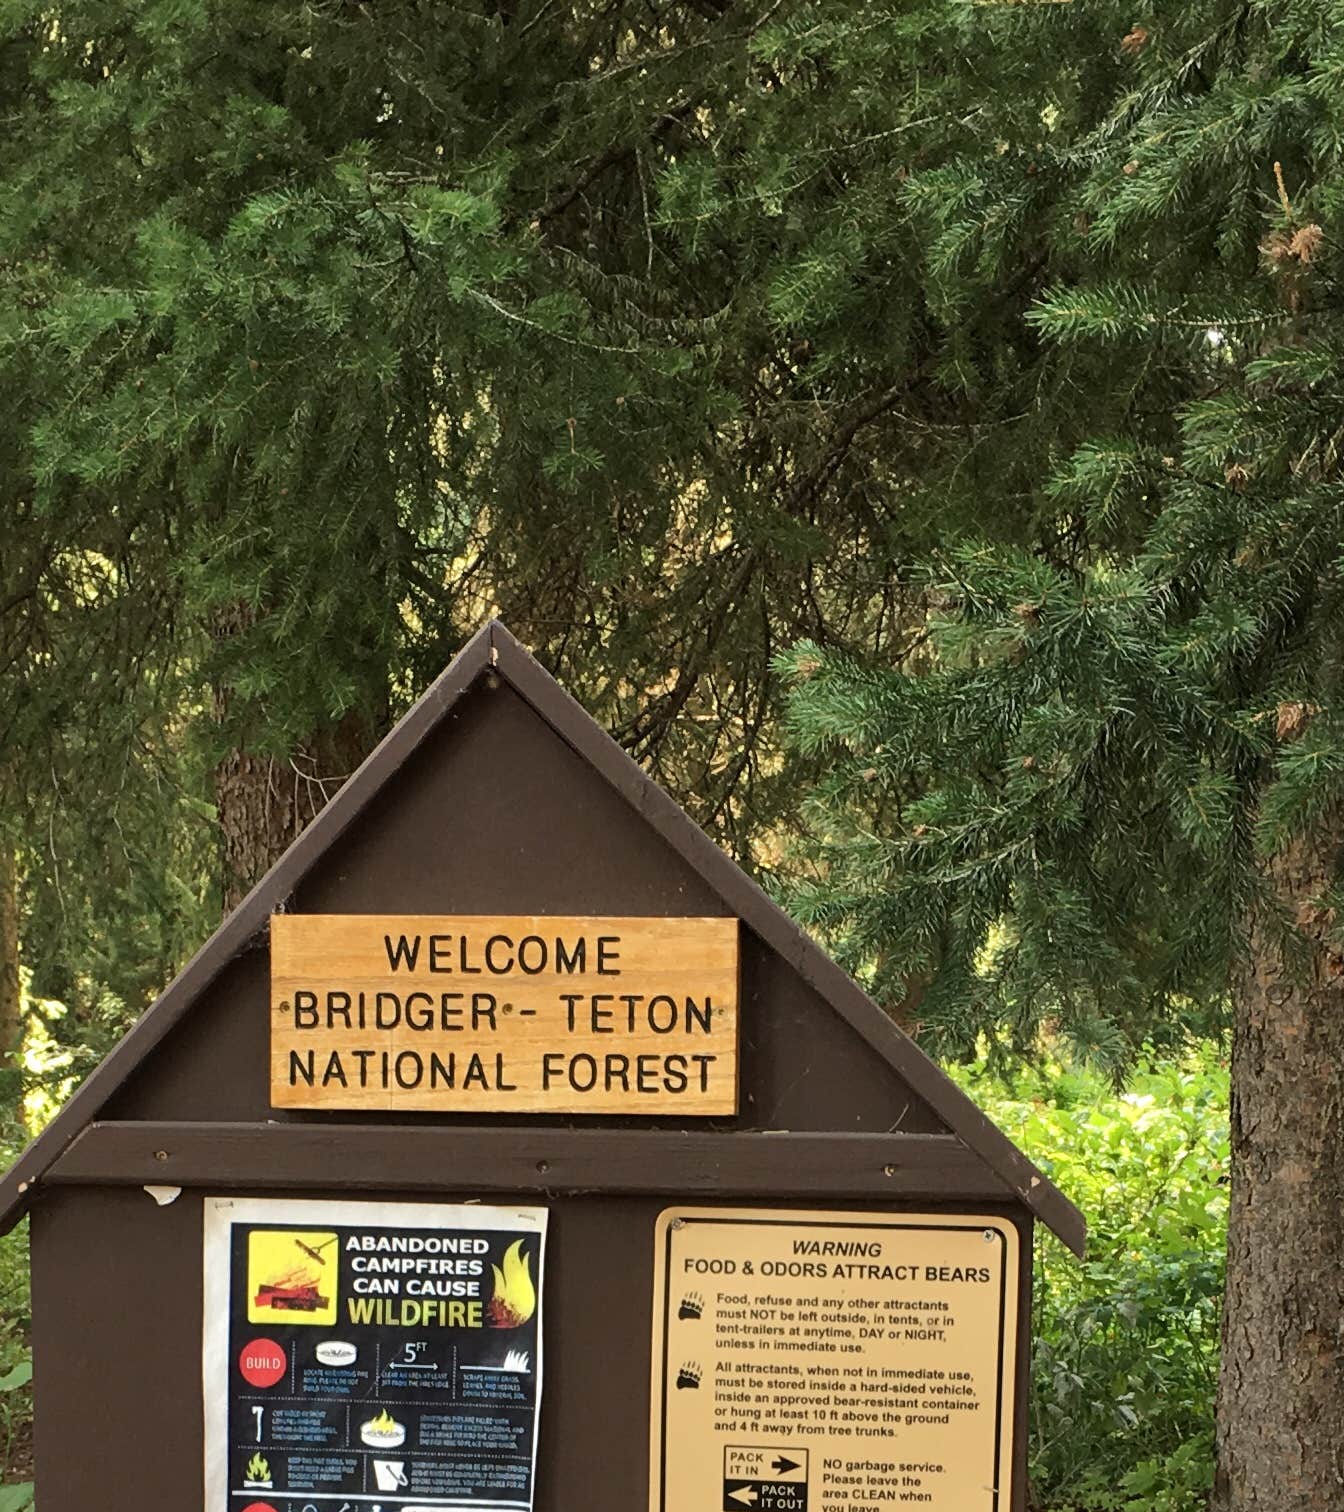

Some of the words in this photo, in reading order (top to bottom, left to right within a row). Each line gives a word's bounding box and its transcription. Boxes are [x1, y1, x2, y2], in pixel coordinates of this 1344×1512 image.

[383, 934, 621, 976] WELCOME
[558, 994, 712, 1034] TETON
[289, 1049, 517, 1091] NATIONAL
[542, 1052, 717, 1093] FOREST
[345, 1235, 489, 1254] ABANDONED
[793, 1239, 882, 1257] WARNING
[351, 1256, 483, 1275] CAMPFIRES
[684, 1258, 736, 1274] FOOD
[741, 1260, 754, 1275] &
[760, 1260, 827, 1278] ODORS
[832, 1263, 919, 1280] ATTRACT
[925, 1266, 990, 1283] BEARS
[352, 1277, 399, 1294] CAN
[405, 1279, 479, 1296] CAUSE
[716, 1292, 750, 1305] Food,
[754, 1294, 792, 1306] refuse
[795, 1296, 818, 1307] and
[821, 1298, 844, 1310] any
[847, 1297, 880, 1309] other
[883, 1299, 949, 1311] attractants
[347, 1297, 483, 1328] WILDFIRE
[715, 1309, 746, 1319] must
[749, 1308, 776, 1320] NOT
[779, 1310, 794, 1321] be
[798, 1310, 817, 1322] left
[820, 1312, 869, 1324] outside,
[873, 1313, 885, 1324] in
[888, 1314, 922, 1326] tents,
[926, 1316, 939, 1326] or
[942, 1315, 954, 1326] in
[715, 1323, 785, 1335] tent-trailers
[788, 1326, 800, 1336] at
[803, 1326, 855, 1339] anytime,
[858, 1327, 884, 1339] DAY
[887, 1330, 901, 1339] or
[904, 1328, 946, 1342] NIGHT,
[715, 1338, 755, 1349] unless
[758, 1338, 770, 1349] in
[773, 1339, 836, 1352] immediate
[839, 1344, 864, 1353] use.
[246, 1356, 281, 1369] BUILD
[715, 1361, 731, 1372] All
[734, 1362, 803, 1376] attractants,
[806, 1364, 839, 1376] when
[842, 1367, 863, 1377] not
[866, 1366, 877, 1377] in
[881, 1367, 945, 1380] immediate
[948, 1371, 973, 1382] use,
[714, 1377, 745, 1387] must
[748, 1377, 763, 1388] be
[766, 1378, 805, 1390] stored
[808, 1379, 846, 1391] inside
[849, 1383, 856, 1392] a
[860, 1381, 926, 1394] hard-sided
[928, 1383, 976, 1397] vehicle,
[714, 1391, 751, 1402] inside
[754, 1394, 769, 1403] an
[772, 1394, 830, 1406] approved
[833, 1394, 918, 1408] bear-resistant
[921, 1399, 980, 1410] container
[714, 1407, 727, 1416] or
[730, 1405, 761, 1420] hung
[764, 1408, 776, 1418] at
[779, 1408, 808, 1420] least
[812, 1408, 826, 1420] 10
[829, 1409, 838, 1420] ft
[841, 1410, 878, 1422] above
[881, 1411, 901, 1423] the
[904, 1413, 949, 1426] ground
[714, 1420, 736, 1431] and
[739, 1420, 747, 1431] 4
[750, 1421, 759, 1432] ft
[762, 1424, 793, 1436] away
[796, 1423, 825, 1434] from
[828, 1425, 852, 1436] tree
[729, 1451, 763, 1462] PACK
[823, 1458, 842, 1469] NO
[845, 1459, 895, 1474] garbage
[729, 1464, 741, 1474] IT
[745, 1465, 758, 1475] IN
[822, 1473, 863, 1485] Please
[866, 1474, 898, 1486] leave
[901, 1475, 921, 1487] the
[761, 1484, 795, 1496] PACK
[822, 1489, 848, 1499] area
[851, 1488, 895, 1500] CLEAN
[898, 1490, 932, 1502] when
[761, 1497, 773, 1508] IT
[776, 1498, 803, 1509] OUT
